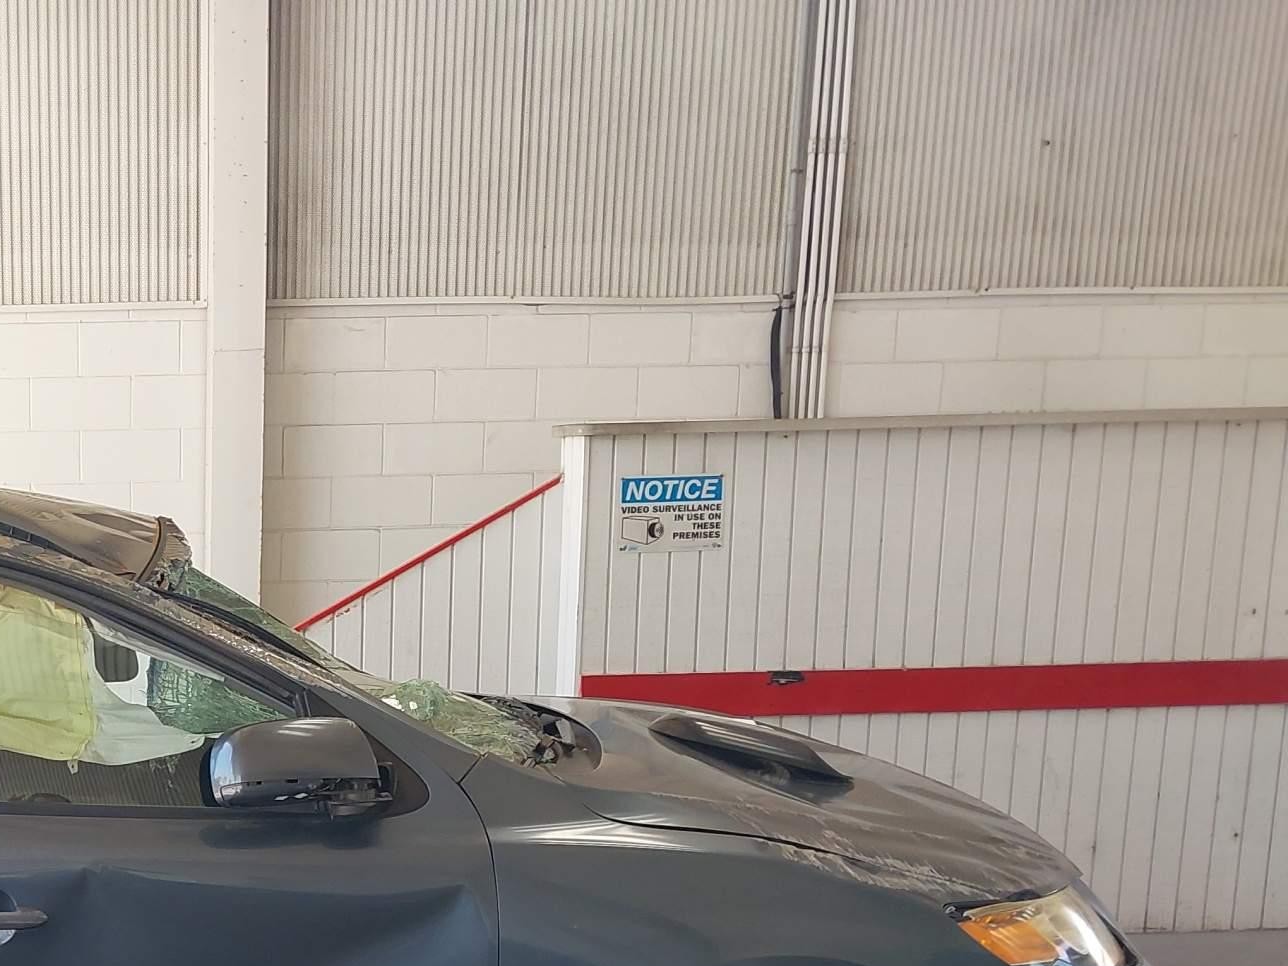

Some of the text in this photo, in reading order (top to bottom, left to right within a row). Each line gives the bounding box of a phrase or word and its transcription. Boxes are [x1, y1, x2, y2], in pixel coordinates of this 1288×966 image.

[625, 479, 719, 501] NOTICE
[621, 503, 722, 514] VIDEO SURVEILLANCE
[687, 513, 705, 521] USE
[692, 522, 721, 530] THESE
[672, 531, 721, 540] PREMISES
